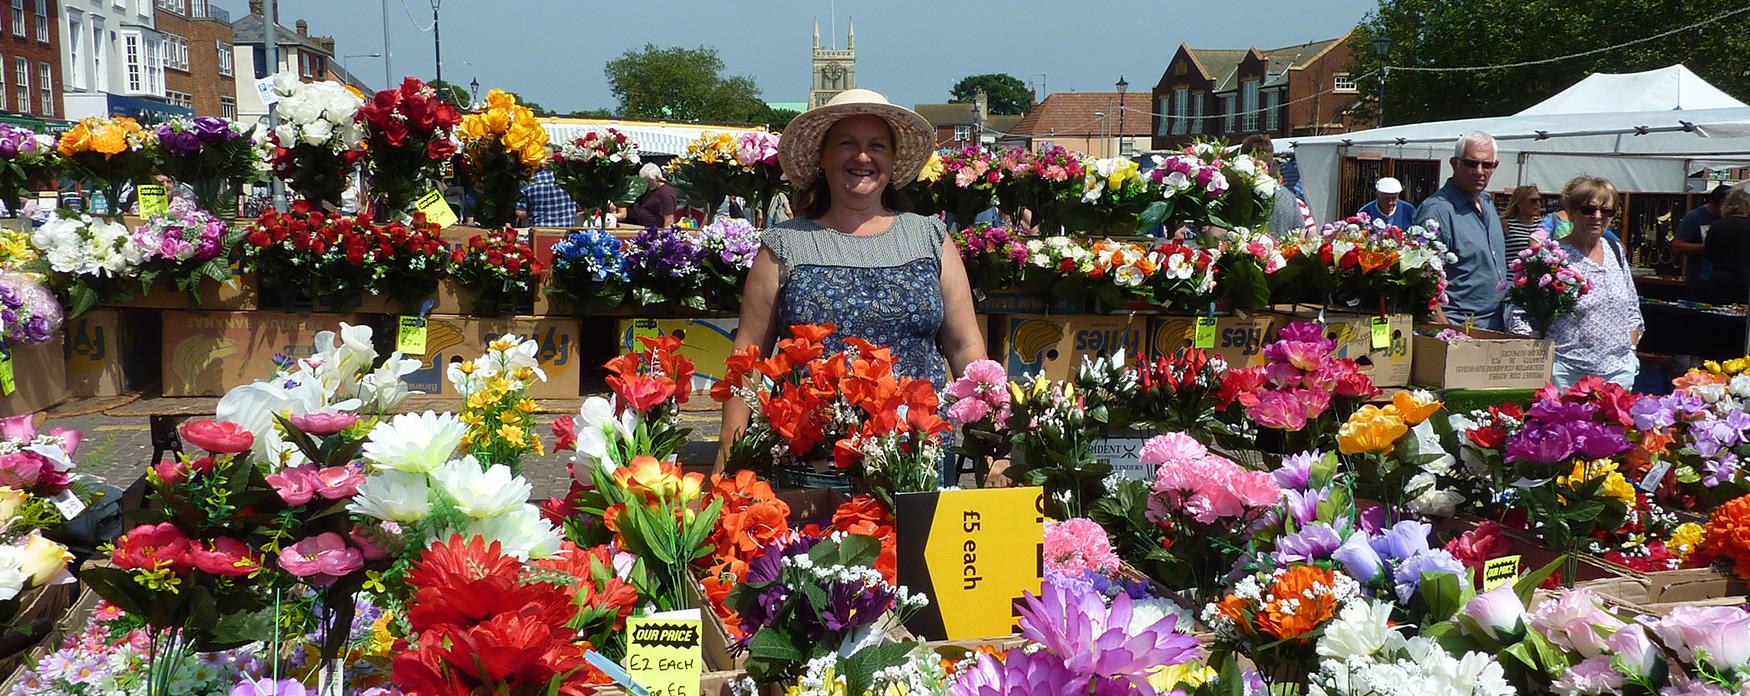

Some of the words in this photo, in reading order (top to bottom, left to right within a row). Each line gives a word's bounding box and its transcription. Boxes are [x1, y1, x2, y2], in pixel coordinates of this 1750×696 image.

[185, 318, 252, 329] BANANAS
[1088, 444, 1122, 454] RIDENT
[963, 510, 981, 533] £5
[963, 540, 983, 590] each
[636, 628, 659, 641] OUR
[660, 629, 693, 642] PRICE
[630, 653, 653, 671] £2
[659, 658, 694, 671] EACH
